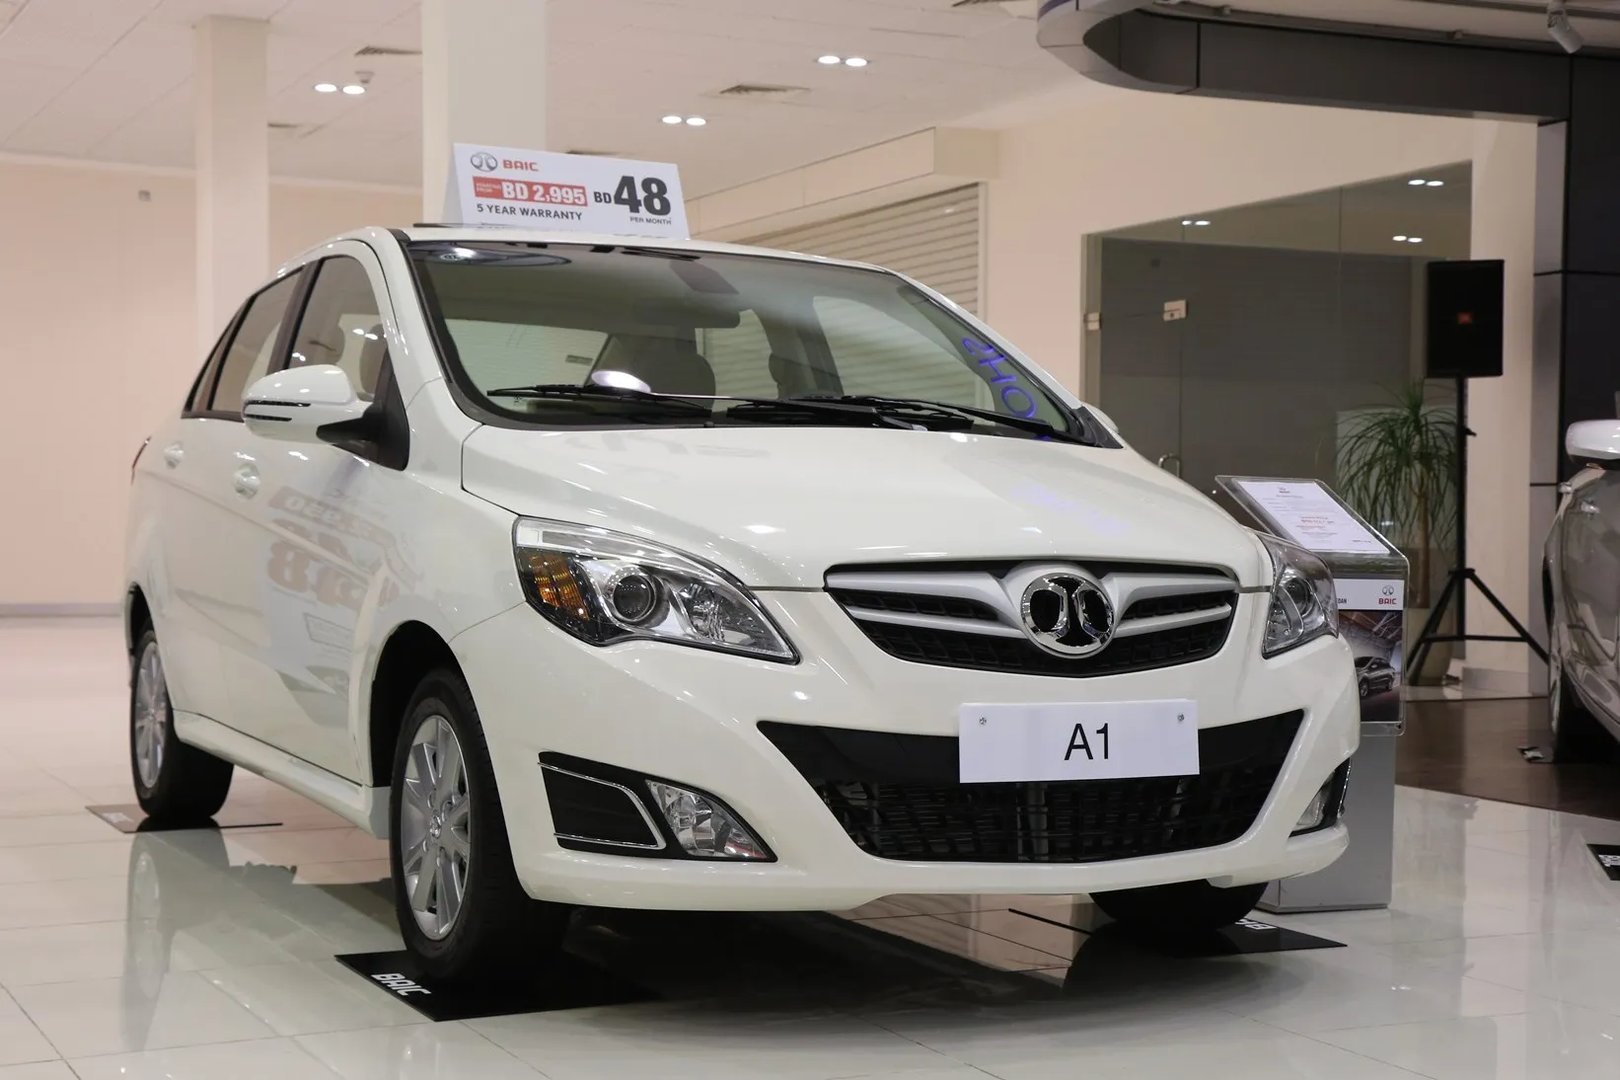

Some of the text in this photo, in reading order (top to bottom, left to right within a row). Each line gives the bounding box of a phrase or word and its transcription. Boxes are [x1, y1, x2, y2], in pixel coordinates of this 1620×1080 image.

[503, 159, 539, 171] BAIC
[501, 181, 528, 200] BD
[532, 184, 586, 205] 2,995
[593, 175, 671, 216] BD 48
[477, 203, 582, 221] 5 YEAR WARRANTY
[646, 217, 672, 225] MONTH
[1378, 597, 1397, 605] BAIC
[1064, 722, 1109, 760] A1
[371, 972, 432, 996] BAIC
